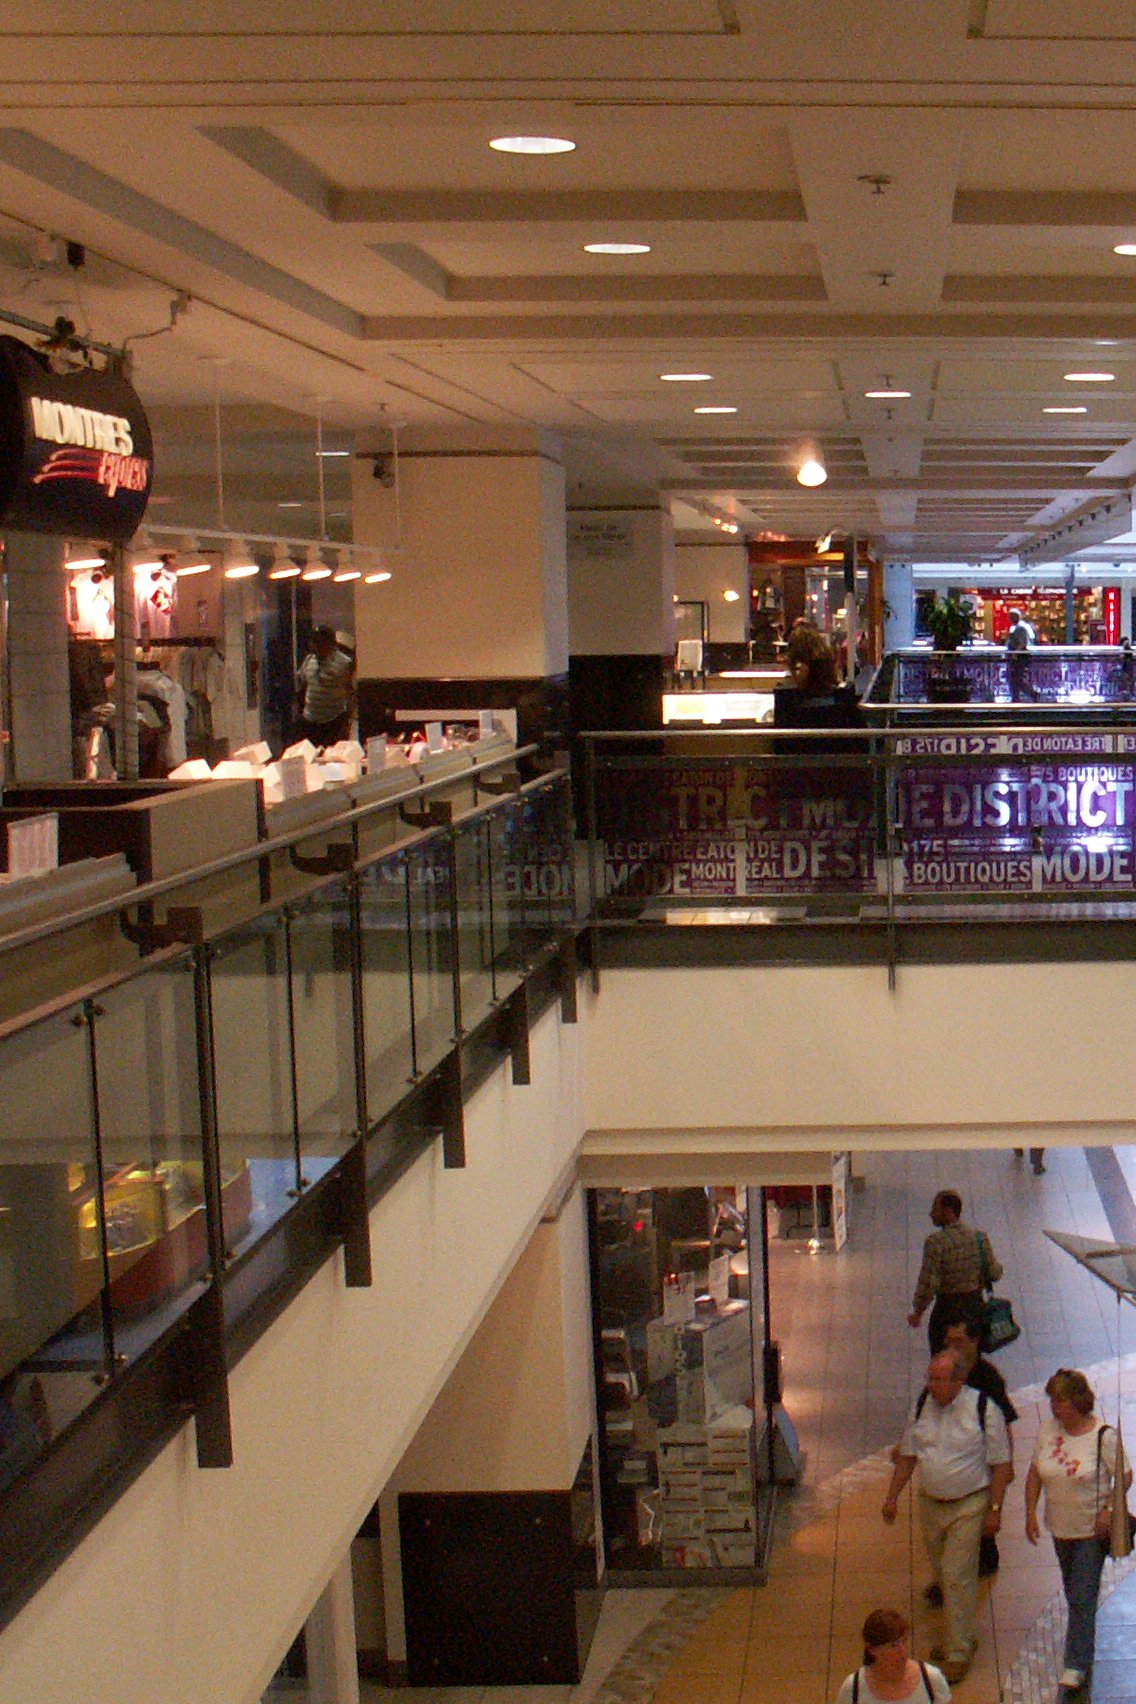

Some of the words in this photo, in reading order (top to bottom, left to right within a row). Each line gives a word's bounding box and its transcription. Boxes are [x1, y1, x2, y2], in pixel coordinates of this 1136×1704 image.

[31, 396, 134, 456] MONTRES
[942, 781, 1134, 829] DISTRICT
[912, 860, 1032, 884] BOUTIQUES
[1039, 844, 1133, 883] MODE
